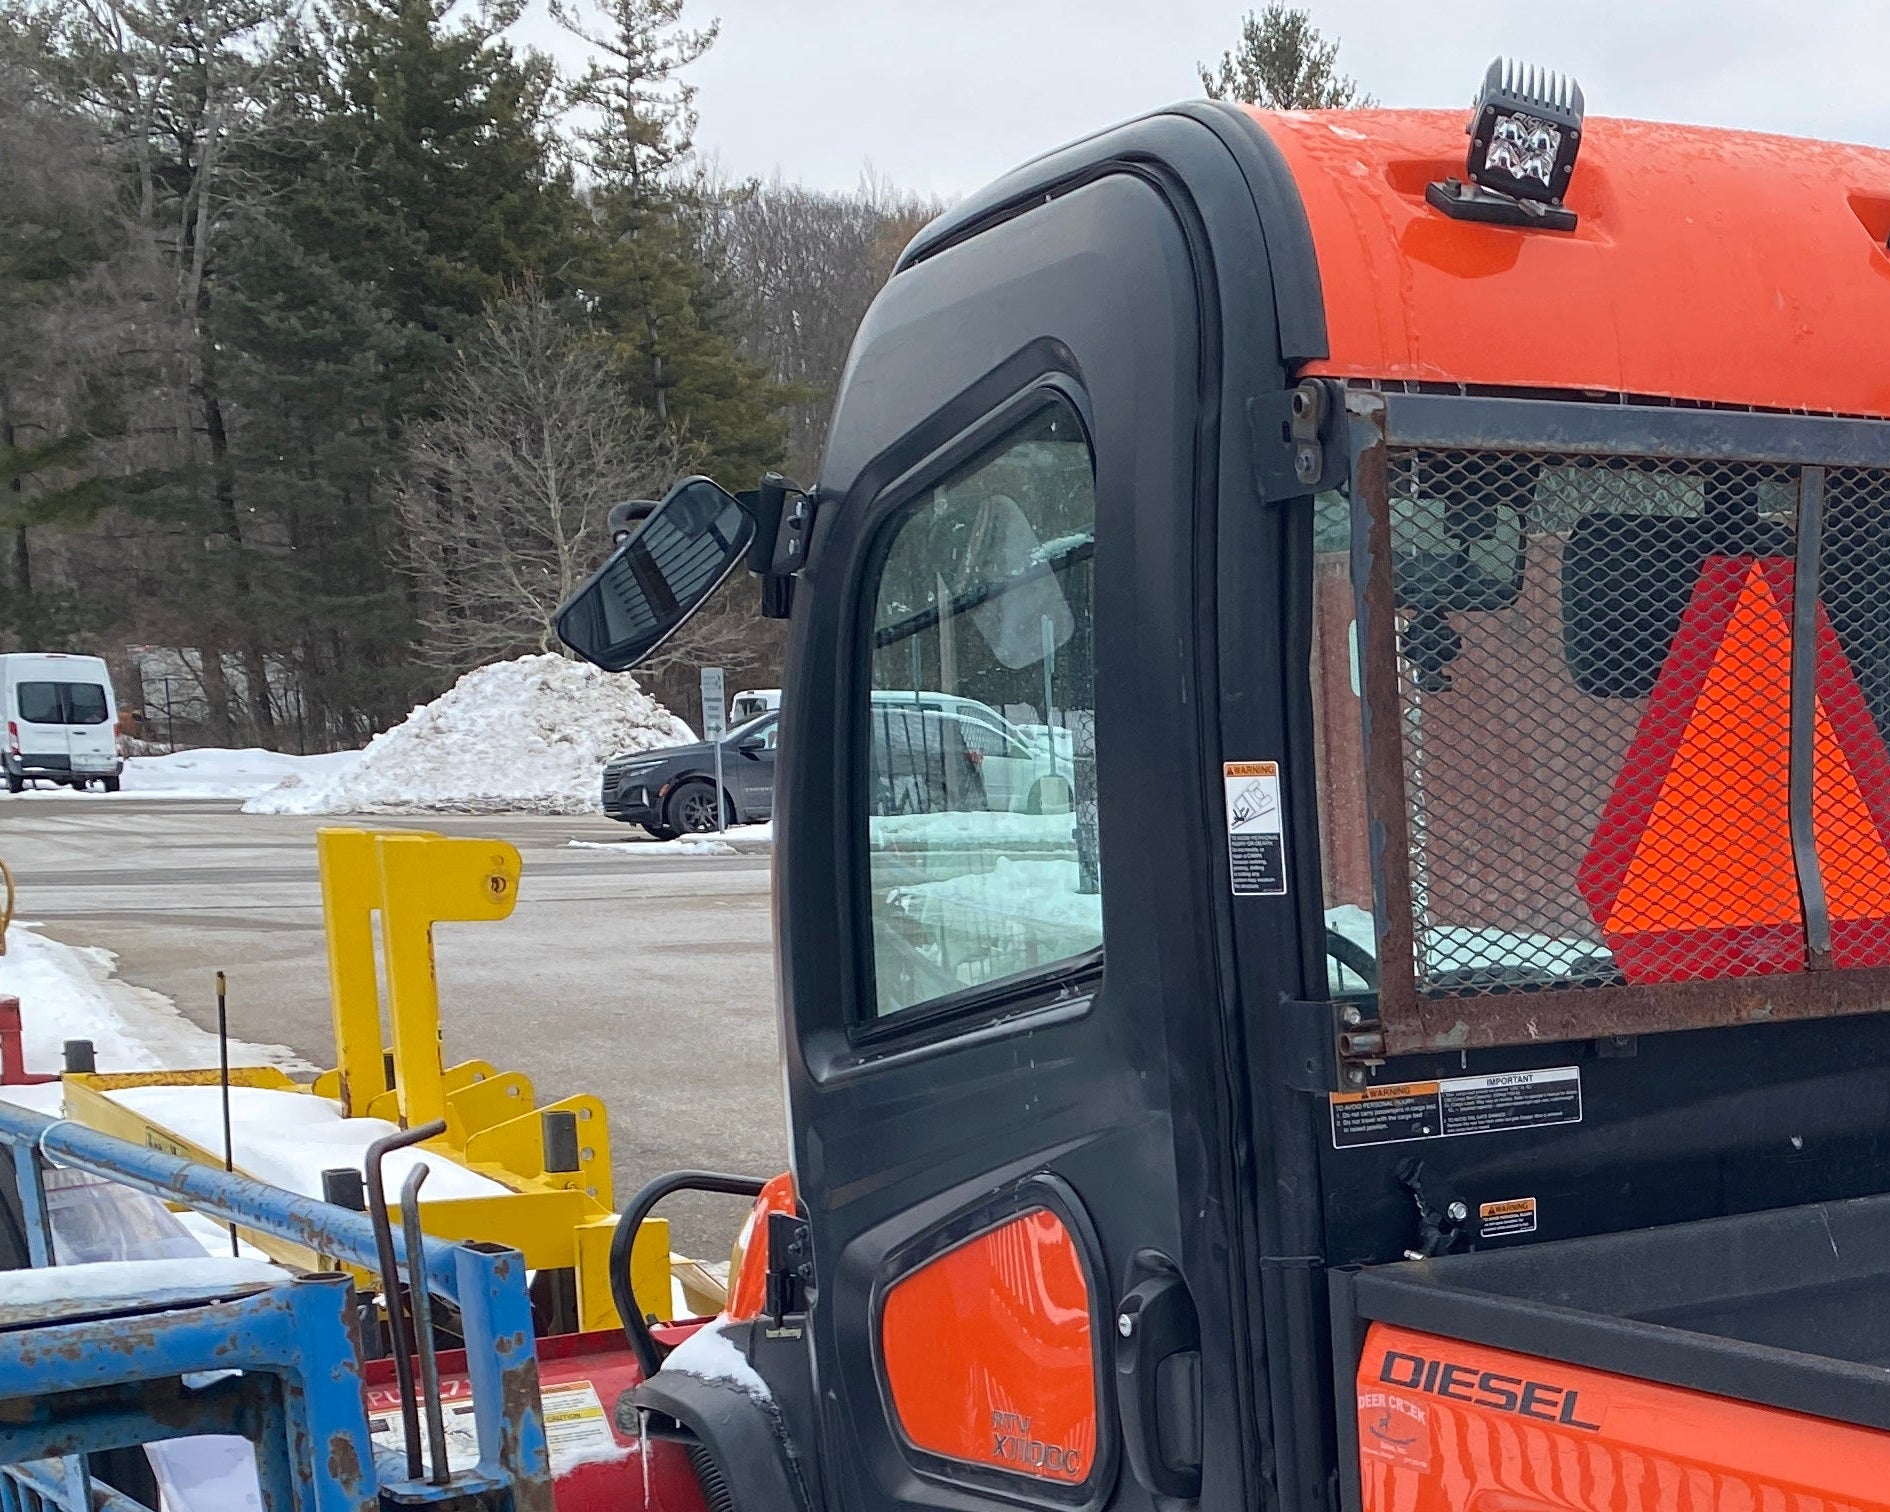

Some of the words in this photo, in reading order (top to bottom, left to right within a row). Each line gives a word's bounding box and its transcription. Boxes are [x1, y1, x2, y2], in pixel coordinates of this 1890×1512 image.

[1234, 765, 1274, 776] WARNING
[1486, 1073, 1534, 1087] IMPORTANT
[1369, 1086, 1410, 1099] WARNING
[1379, 1350, 1601, 1431] DIESEL
[1358, 1393, 1386, 1410] DEER
[993, 1410, 1031, 1434] RTV
